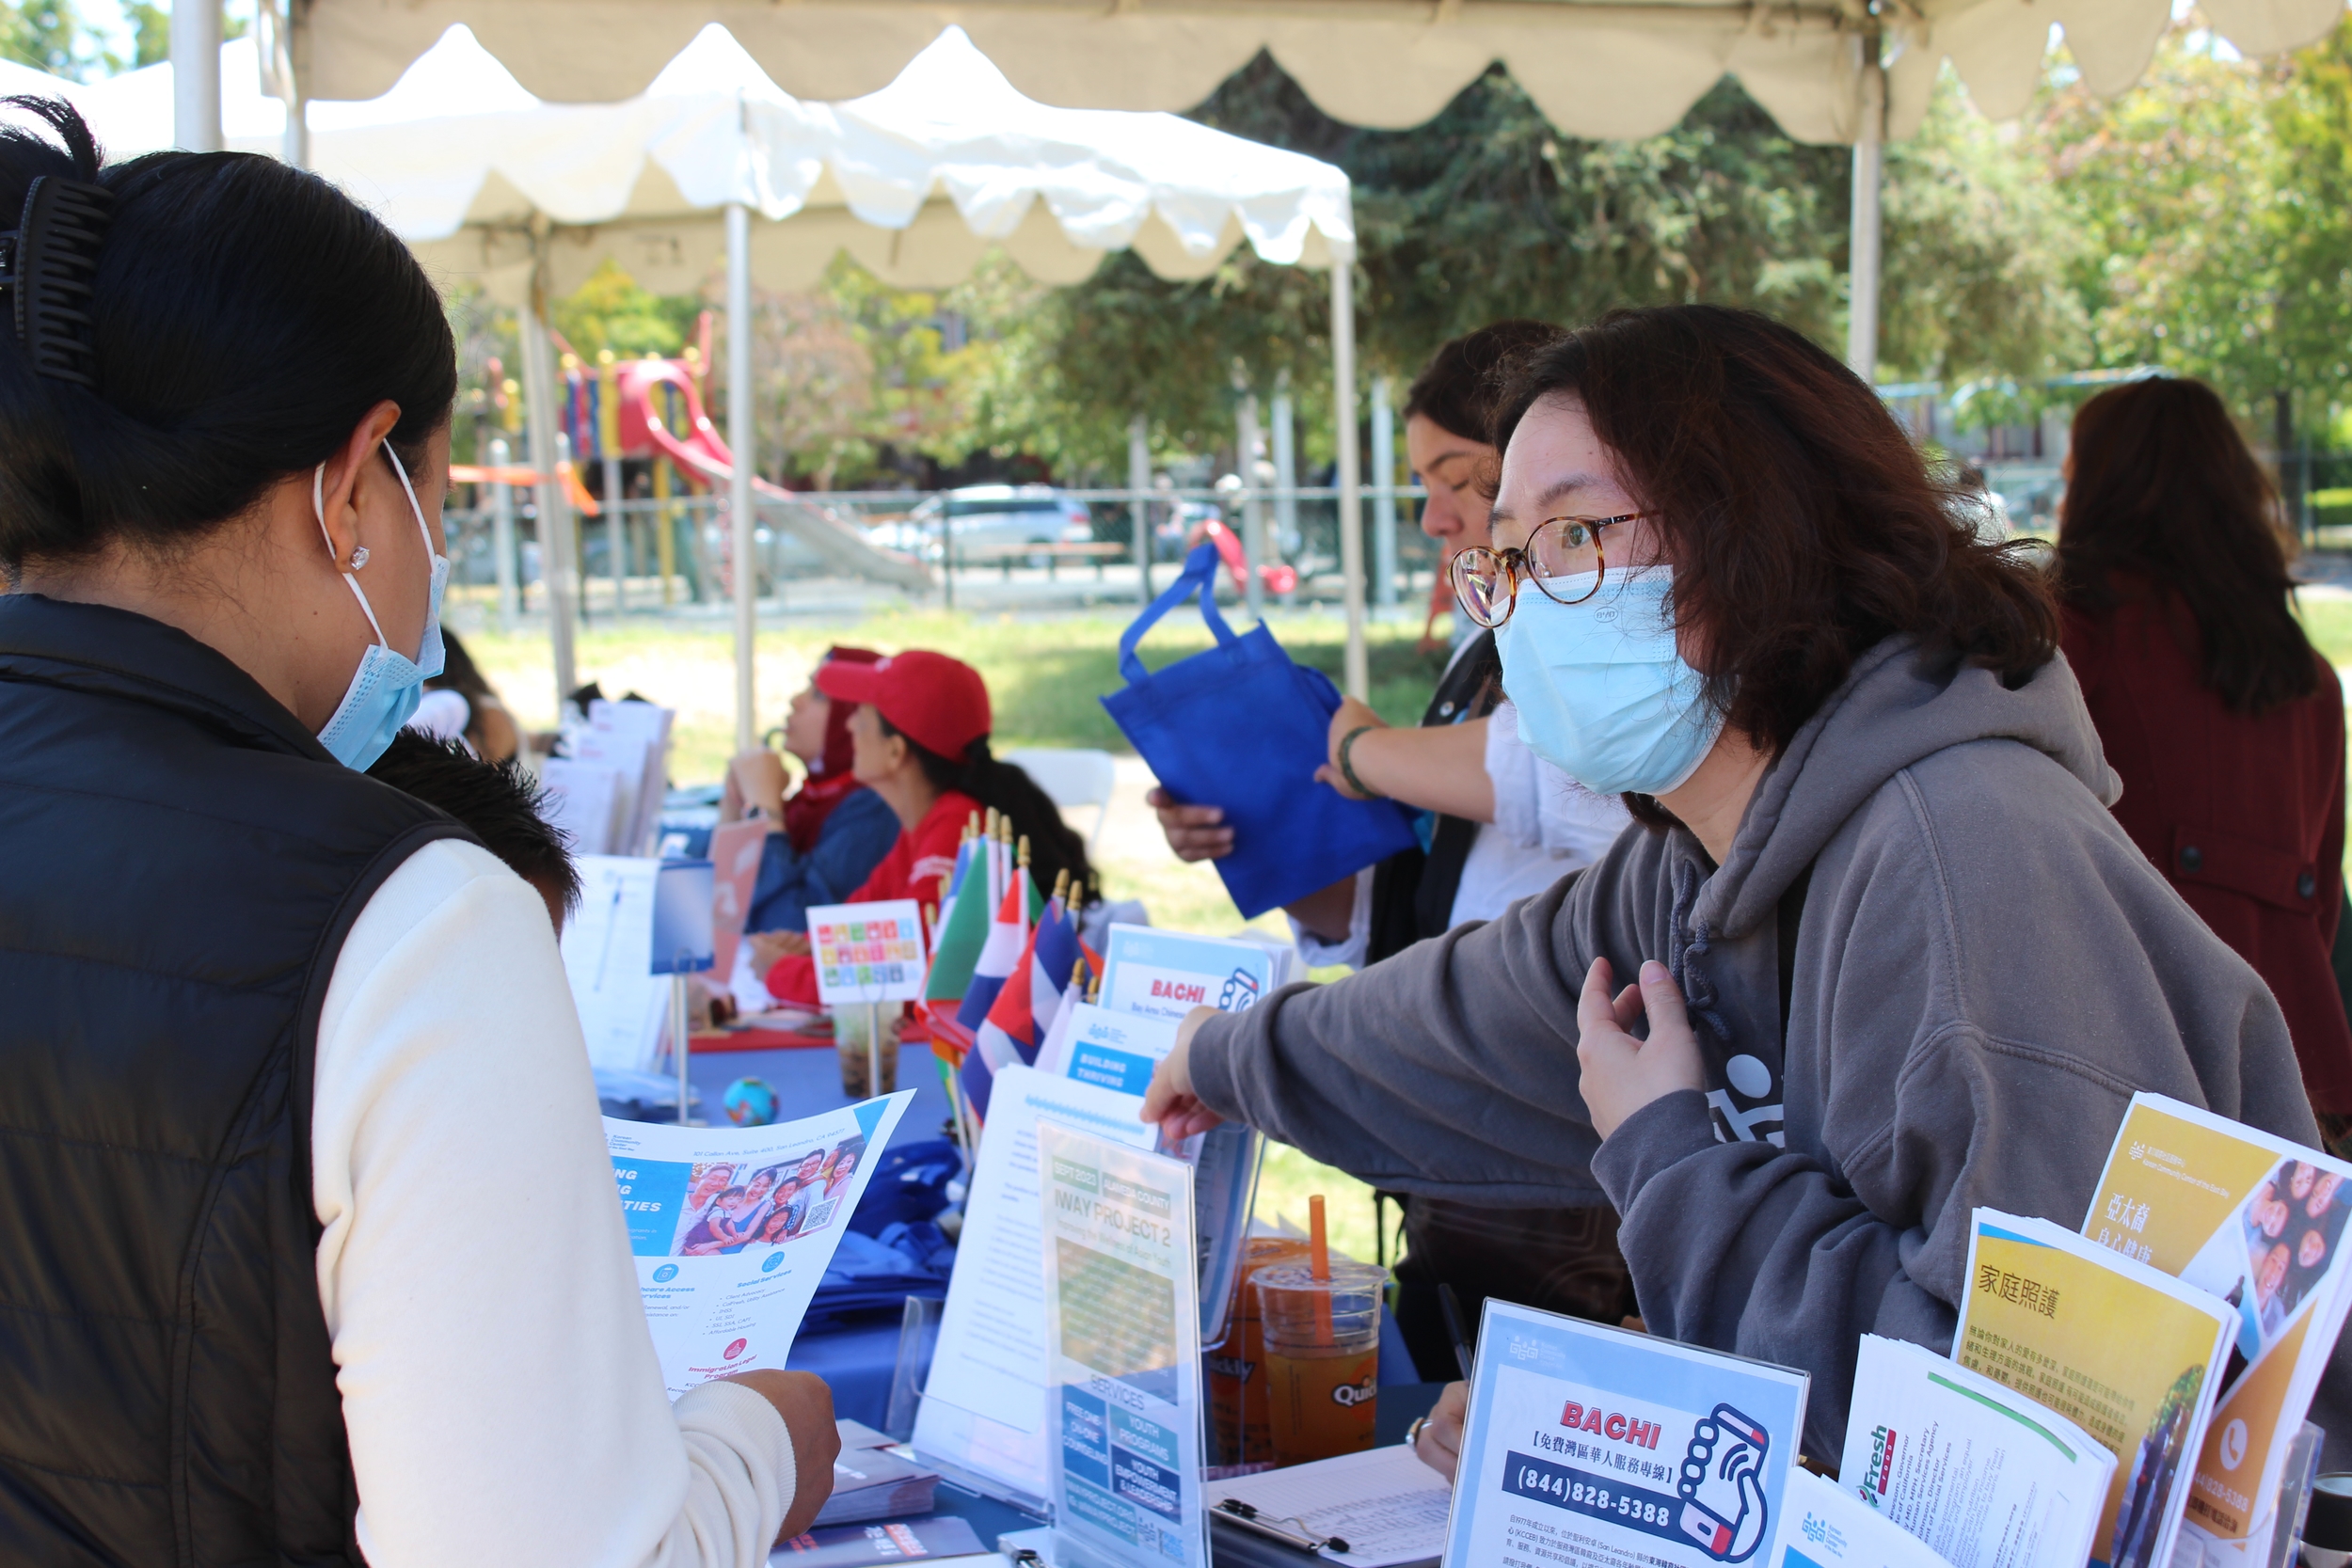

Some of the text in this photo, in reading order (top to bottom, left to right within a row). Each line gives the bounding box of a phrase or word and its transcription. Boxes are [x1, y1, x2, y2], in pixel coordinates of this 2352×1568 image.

[1151, 979, 1206, 1004] BACHI
[1077, 1068, 1124, 1088] THRIVING
[1080, 1052, 1127, 1073] BUILDING
[612, 1168, 638, 1180] NG
[1055, 1162, 1097, 1187] SEPT 2023
[2143, 1159, 2157, 1169] Korean
[2157, 1164, 2180, 1180] Community
[2181, 1172, 2196, 1185] Center
[621, 1200, 662, 1212] TIES
[1104, 1179, 1169, 1211] ALAMEDA COUNTY
[2104, 1192, 2151, 1234] 亞太裔
[1055, 1188, 1091, 1218] IWAY
[1094, 1202, 1159, 1243] PROJECT
[737, 1269, 792, 1288] Social Services
[1979, 1264, 2060, 1320] 家庭照護
[688, 1354, 757, 1373] Immigration Legal
[1092, 1377, 1144, 1410] SERVICES
[1334, 1379, 1377, 1406] Quic
[1129, 1415, 1160, 1439] YOUTH
[1560, 1400, 1661, 1450] BACHI
[1063, 1435, 1108, 1465] COUNSELING
[1120, 1428, 1169, 1462] PROGRAMS
[1533, 1430, 1673, 1484] 【免費灣區華人服務專線】
[1864, 1425, 1887, 1491] Fresh
[1897, 1434, 1910, 1479] Governor
[1917, 1458, 1931, 1499] Services
[1926, 1420, 1939, 1457] Agency
[1115, 1464, 1177, 1502] EMPOWERMENT
[1131, 1459, 1159, 1481] YOUTH
[1900, 1455, 1914, 1501] California
[1906, 1503, 1914, 1521] MD,
[1910, 1476, 1920, 1501] MPH,
[1915, 1427, 1930, 1474] Secretary
[1927, 1457, 1941, 1498] Director
[1929, 1511, 1935, 1525] of
[1932, 1484, 1941, 1515] Social
[1938, 1441, 1952, 1481] Services
[1126, 1481, 1174, 1513] LEADERSHIP
[1518, 1465, 1670, 1527] (844)828-5388
[1938, 1524, 1950, 1556] stance
[1962, 1438, 1972, 1466] equal
[1969, 1504, 1984, 1543] benefits
[1984, 1472, 1994, 1492] buy
[1990, 1447, 2001, 1471] fresh
[1978, 1504, 1990, 1533] whole
[1996, 1449, 2006, 1470] lean
[2194, 1472, 2250, 1513] 44)828-5388
[1933, 1467, 1959, 1553] SDA Supplemental
[1954, 1505, 1962, 1524] and
[1954, 1477, 1980, 1558] provides nutrition
[1967, 1513, 1976, 1533] with
[1973, 1495, 1981, 1512] low
[1515, 1529, 1538, 1543] (KCCEB)
[1597, 1541, 1610, 1552] (San
[1611, 1545, 1635, 1560] Leandro)
[1827, 1530, 1847, 1549] Community
